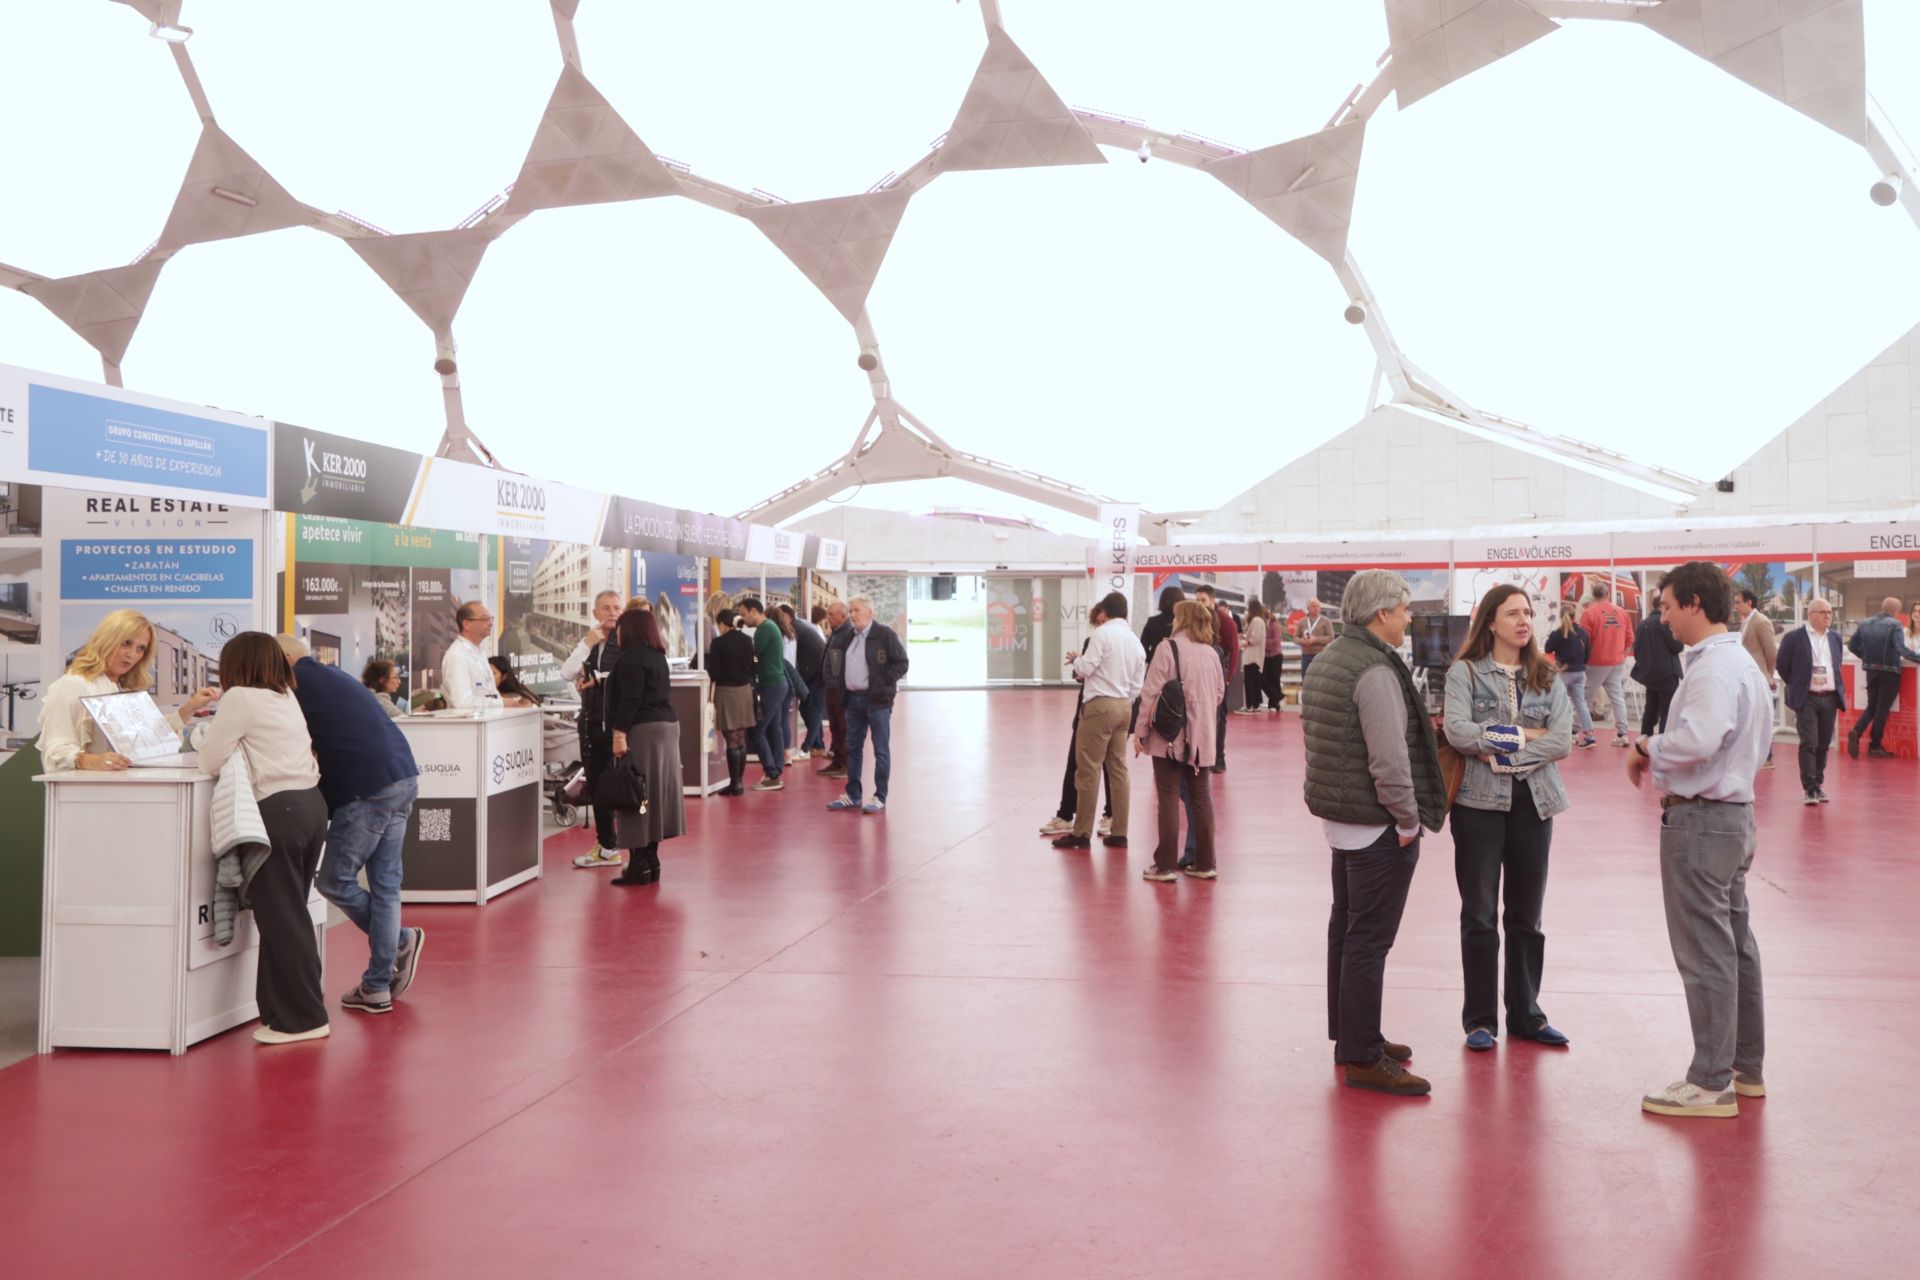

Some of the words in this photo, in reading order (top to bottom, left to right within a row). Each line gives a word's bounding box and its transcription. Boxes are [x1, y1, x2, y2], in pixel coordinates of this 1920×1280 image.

[108, 425, 132, 438] GRUPO
[133, 430, 181, 446] CONSTRUCTORA
[103, 449, 117, 463] DE
[130, 453, 153, 469] AÑOS
[155, 457, 167, 470] DE
[169, 459, 222, 478] EXPERIENCIA
[322, 452, 342, 474] KER
[343, 456, 367, 478] 2000
[497, 480, 519, 508] KER
[520, 484, 545, 511] 2000
[86, 498, 140, 512] REAL
[114, 519, 201, 527] VISION
[624, 513, 633, 533] LA
[302, 524, 341, 543] apetece
[342, 525, 363, 543] vivir
[76, 545, 150, 555] PROYECTOS
[157, 545, 173, 555] EN
[180, 545, 237, 555] ESTUDIO
[131, 560, 180, 569] ZARATÁN
[1135, 553, 1218, 566] NGEL&VÖLKERS
[89, 574, 157, 582] APARTAMENTOS
[160, 574, 172, 582] EN
[111, 585, 148, 593] CHALETS
[150, 585, 162, 593] EN
[165, 585, 201, 593] RENEDO
[509, 652, 519, 668] Tu
[519, 654, 539, 666] nueva
[539, 652, 553, 664] casa
[519, 669, 536, 684] Pinar
[537, 668, 545, 683] de
[506, 748, 534, 771] SUQUIA
[425, 763, 461, 773] SUQUIA
